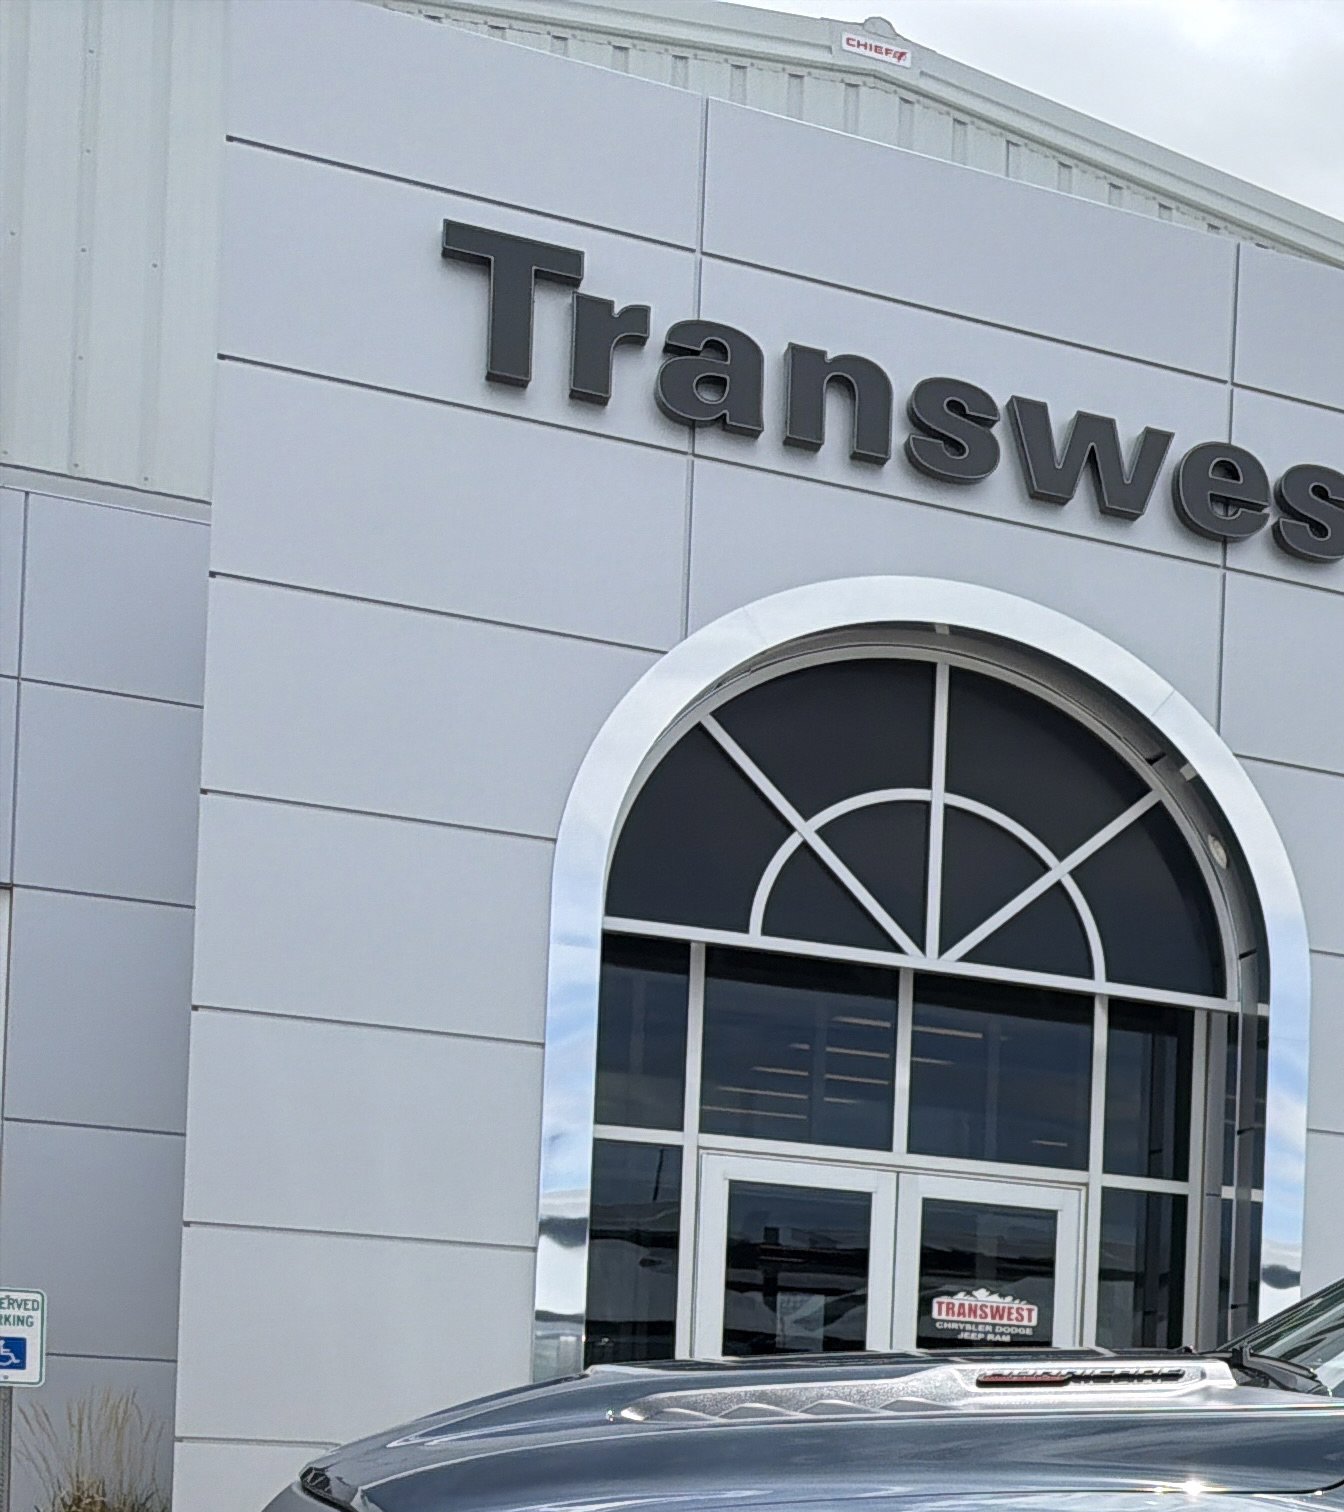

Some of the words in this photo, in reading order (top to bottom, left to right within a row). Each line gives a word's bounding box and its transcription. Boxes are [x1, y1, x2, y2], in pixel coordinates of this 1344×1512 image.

[846, 37, 893, 57] CHIEF
[935, 1300, 1035, 1324] TRANSWEST
[935, 1321, 993, 1333] CHRYSLER
[994, 1325, 1033, 1336] DODGE
[958, 1331, 985, 1341] JEEP
[986, 1333, 1011, 1343] RAM
